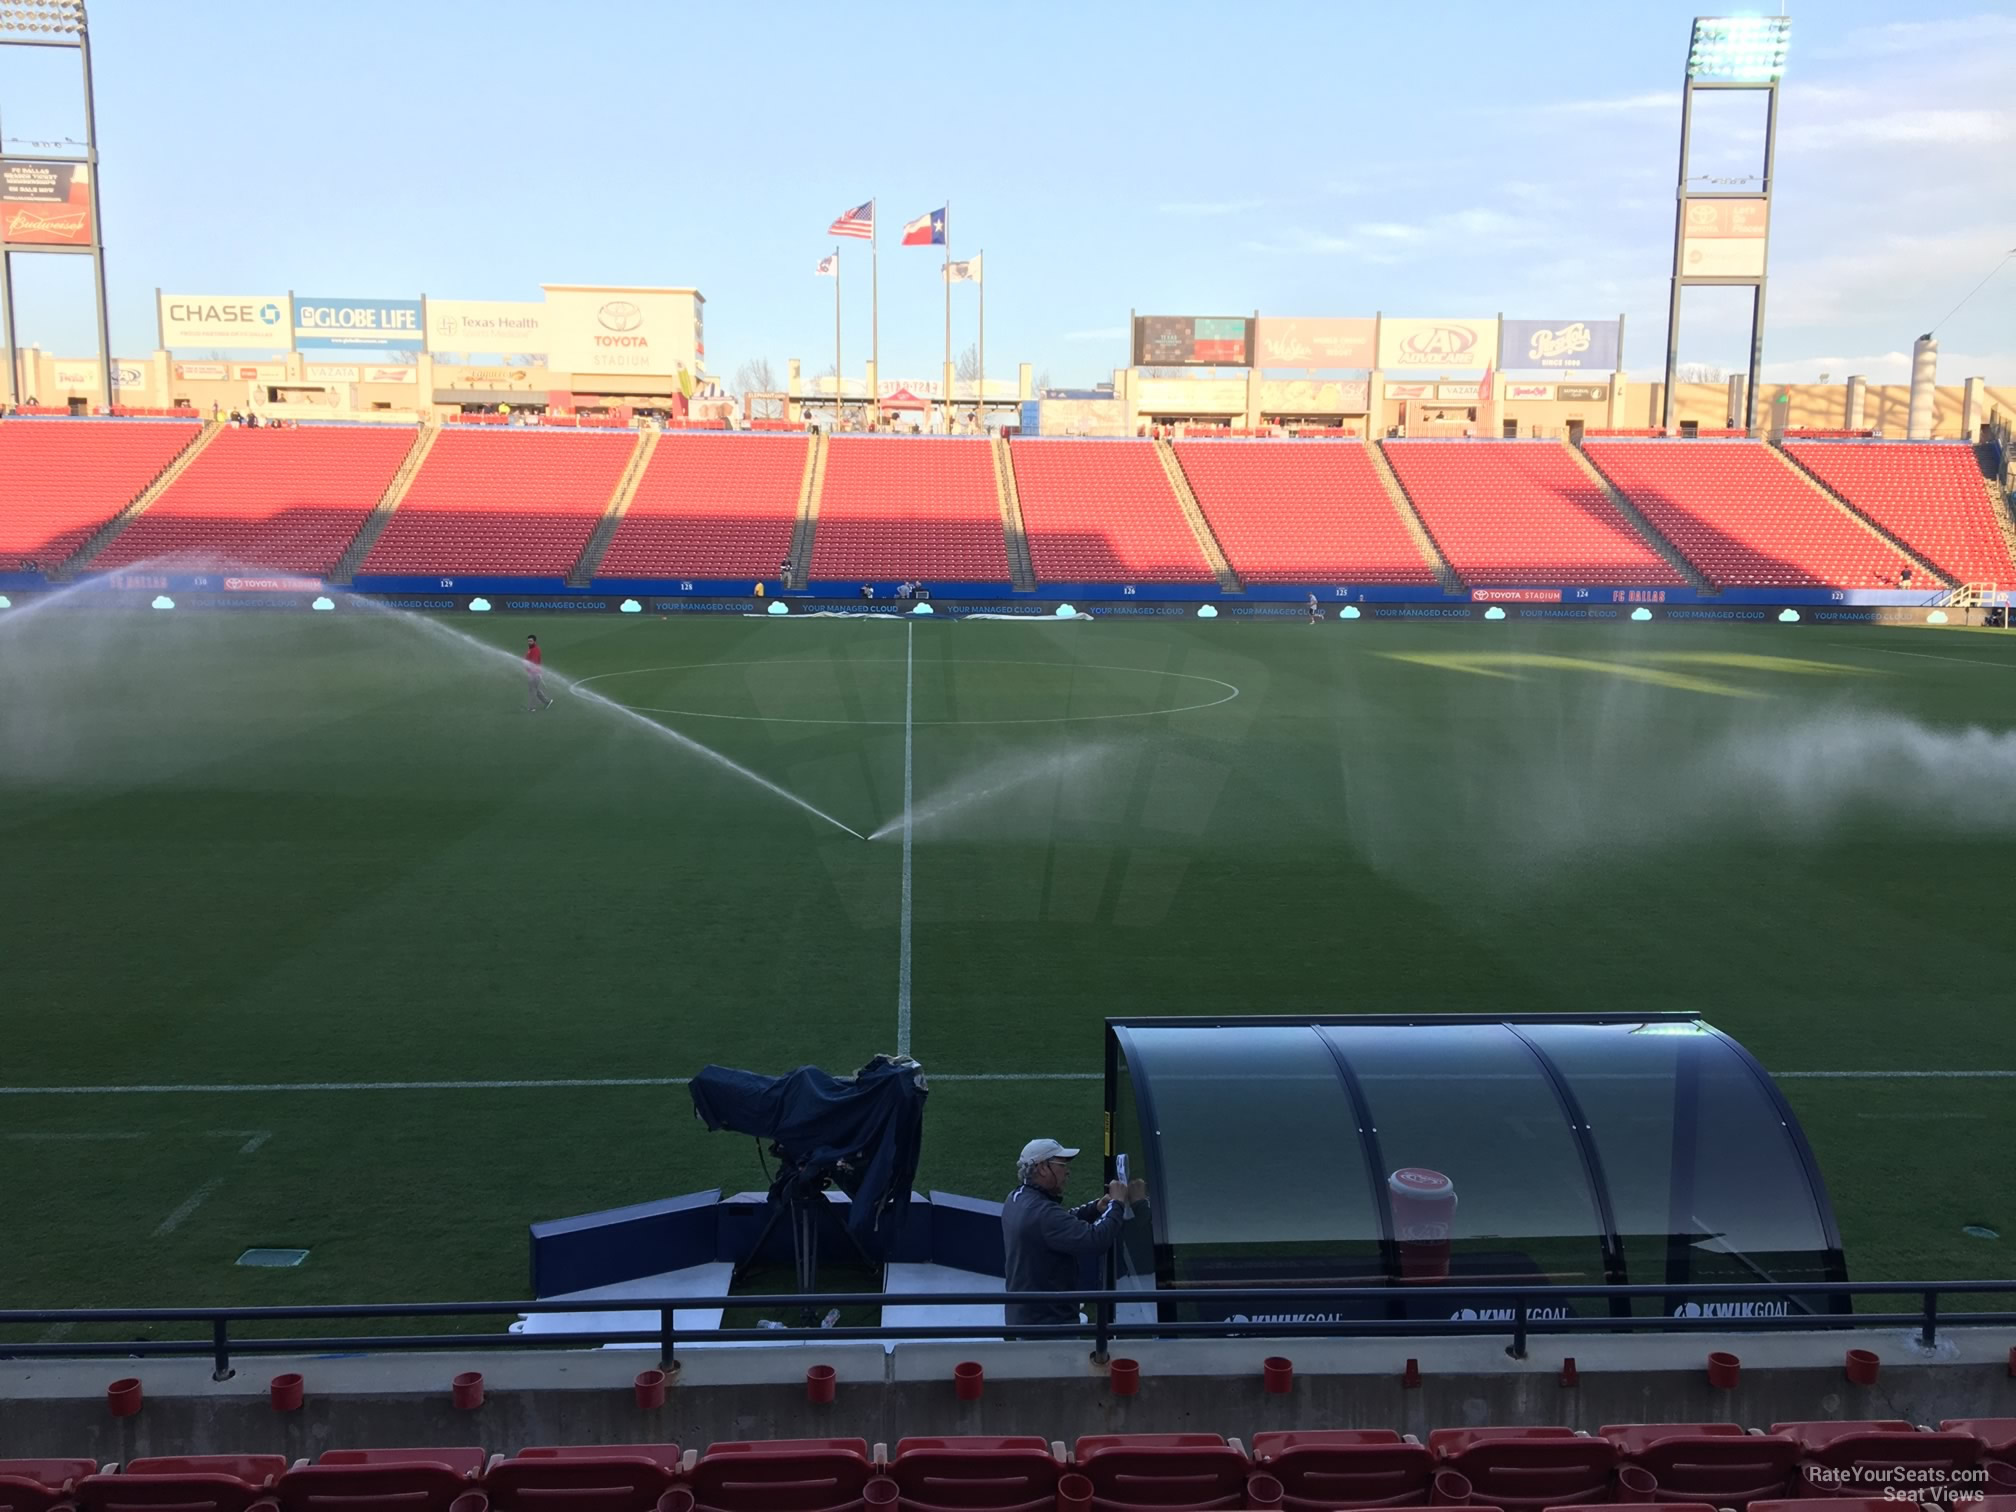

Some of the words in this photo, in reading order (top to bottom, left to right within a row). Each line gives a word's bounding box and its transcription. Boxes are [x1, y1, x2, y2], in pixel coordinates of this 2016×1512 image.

[7, 216, 85, 230] Budweiser
[170, 304, 254, 322] CHASE
[315, 307, 376, 328] GLOBE
[380, 309, 416, 328] LIFE
[462, 316, 495, 328] Texas
[498, 318, 538, 328] Health
[594, 336, 648, 347] TOYOTA
[594, 354, 650, 366] STADIUM
[310, 368, 355, 376] VAZATA
[1613, 591, 1624, 602] FC
[1628, 591, 1665, 602] DALLAS
